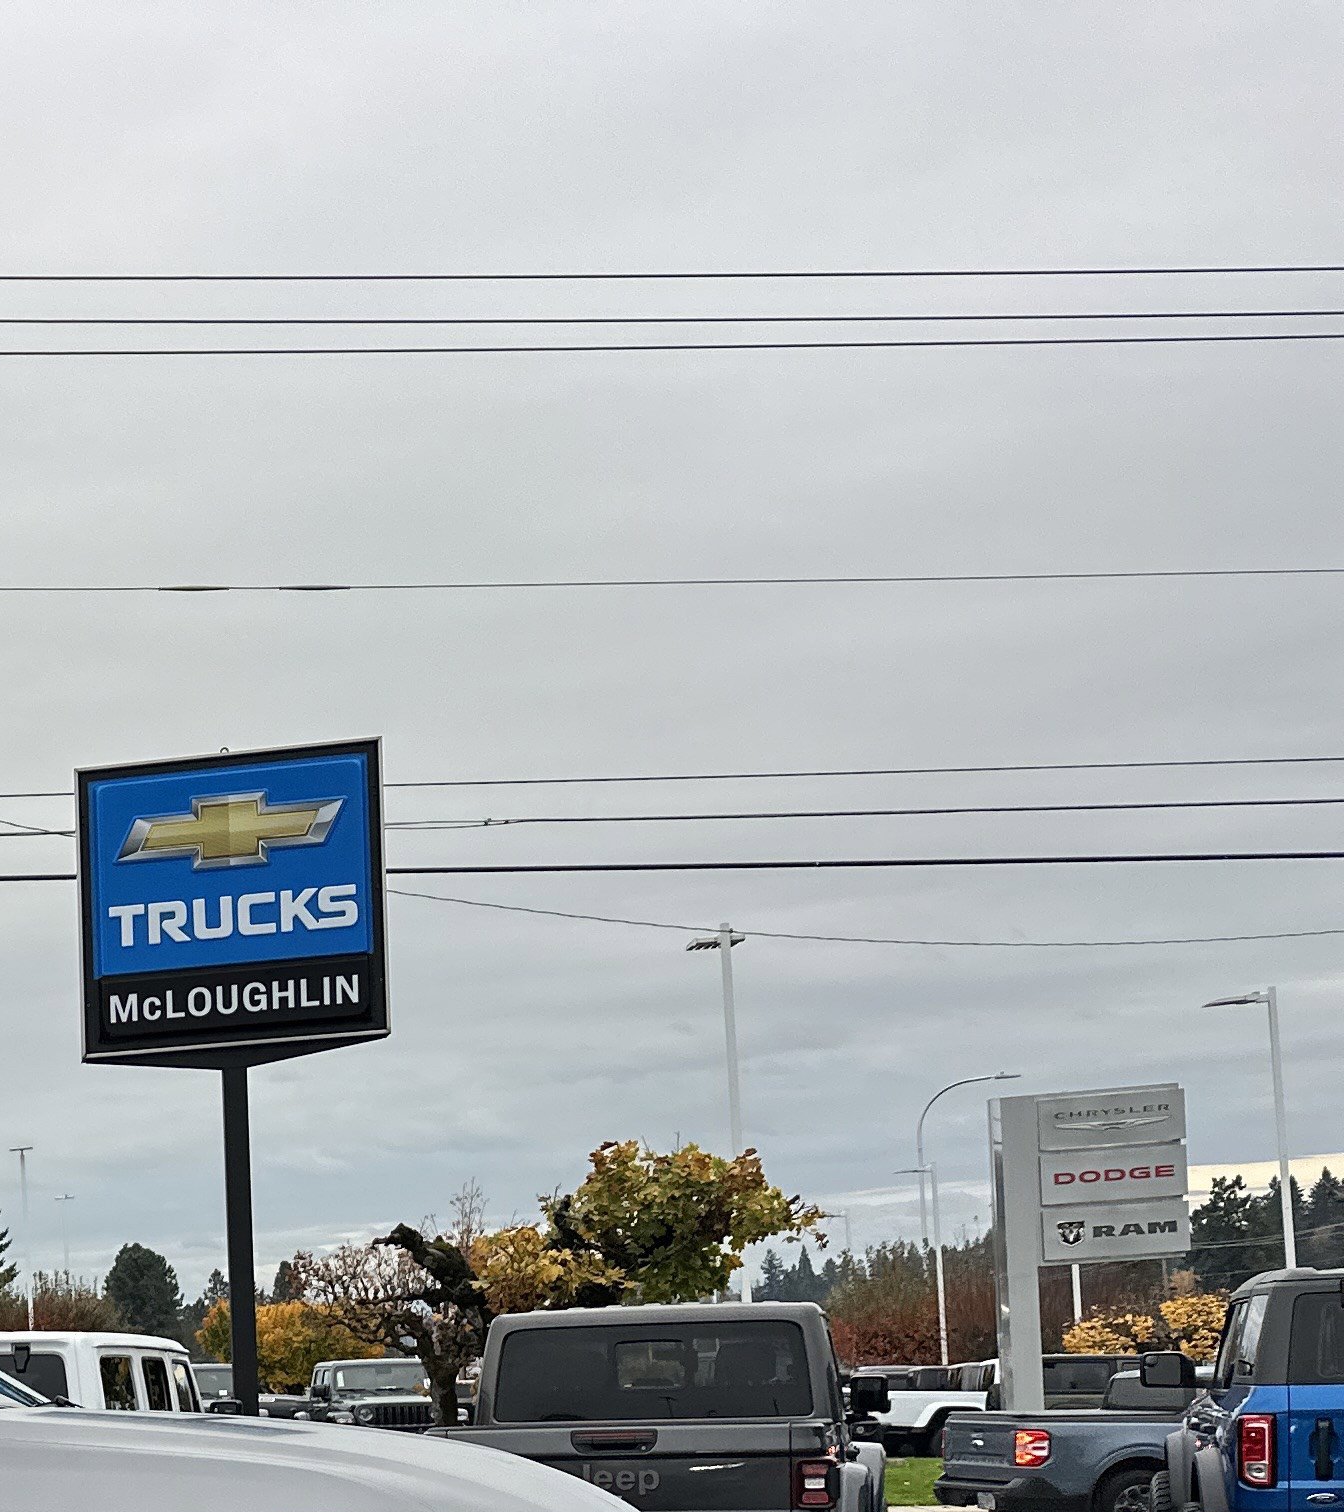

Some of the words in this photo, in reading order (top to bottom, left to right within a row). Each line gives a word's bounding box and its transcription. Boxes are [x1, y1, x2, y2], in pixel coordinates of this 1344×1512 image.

[108, 883, 359, 947] TRUCKS
[109, 973, 360, 1024] McLOUGHLIN
[1054, 1103, 1170, 1120] CHRYSLER
[1054, 1164, 1175, 1185] DODGE
[1092, 1220, 1178, 1238] RAM
